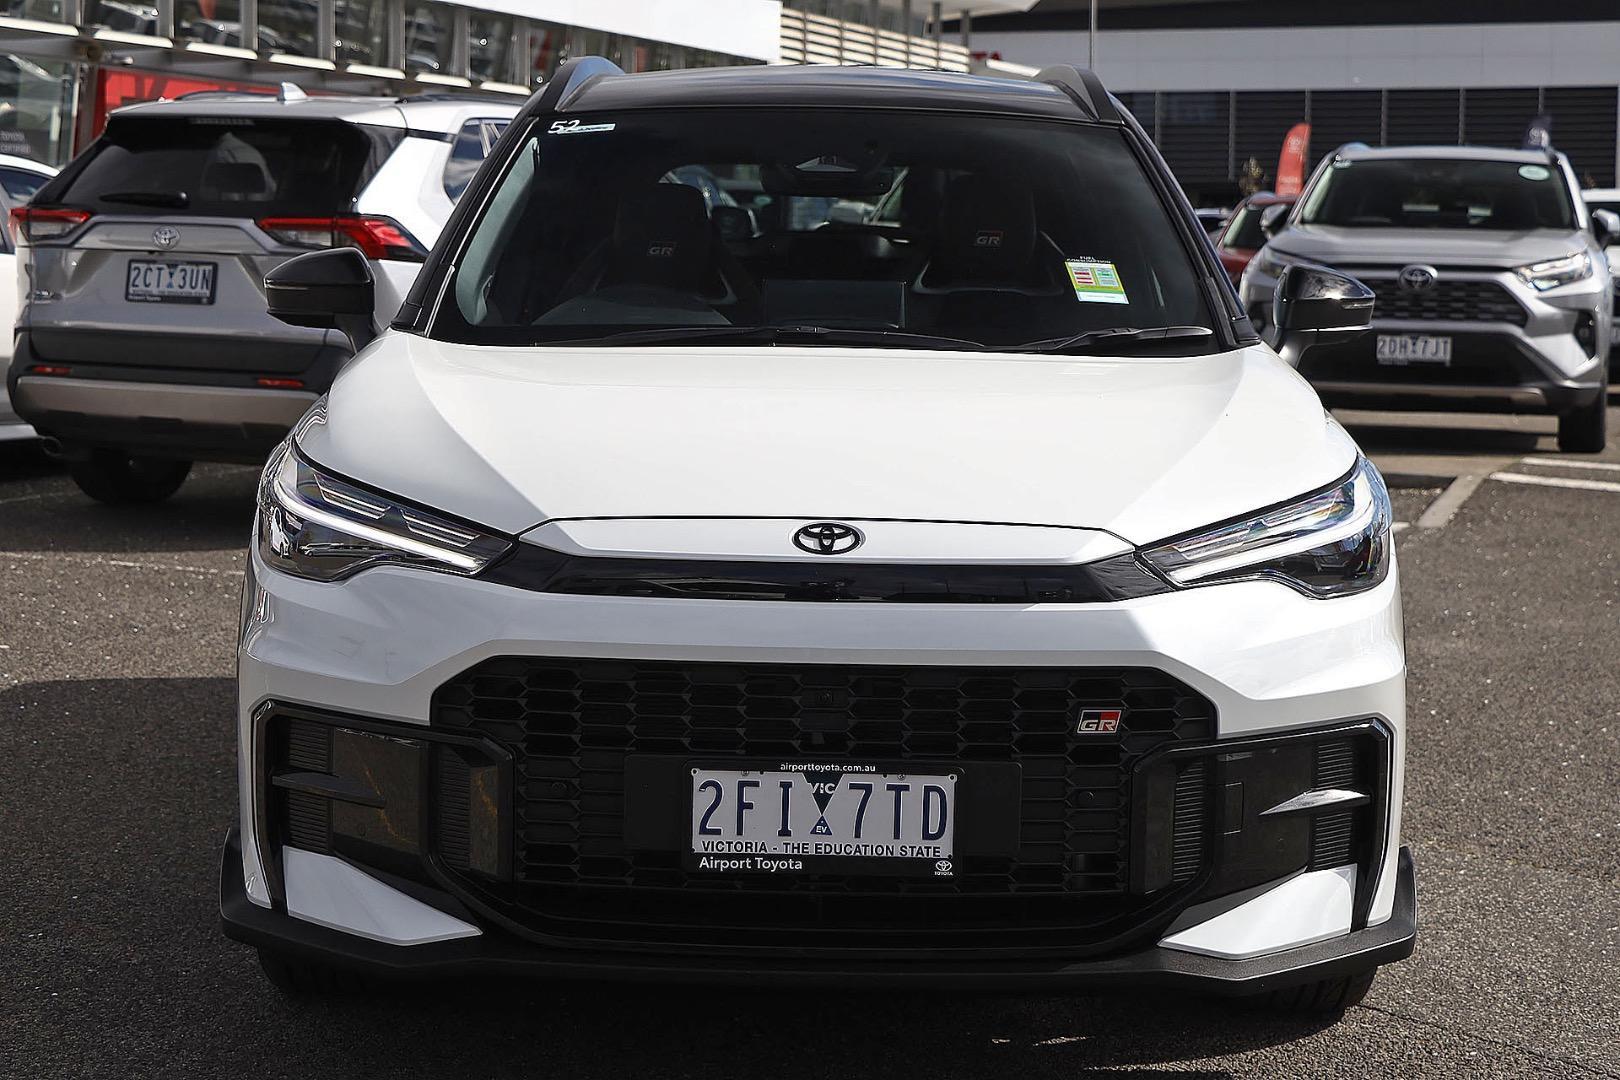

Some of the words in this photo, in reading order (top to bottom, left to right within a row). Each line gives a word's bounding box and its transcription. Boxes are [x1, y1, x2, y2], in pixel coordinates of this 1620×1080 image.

[547, 119, 580, 134] 52
[1081, 719, 1116, 731] GR
[780, 763, 876, 773] airporttoyota.com.au
[816, 825, 828, 834] EV
[702, 841, 768, 853] VICTORIA
[783, 842, 810, 854] THE
[814, 843, 895, 857] EDUCATION
[900, 845, 941, 858] STATE
[699, 856, 752, 872] Airport
[755, 857, 803, 872] Toyota
